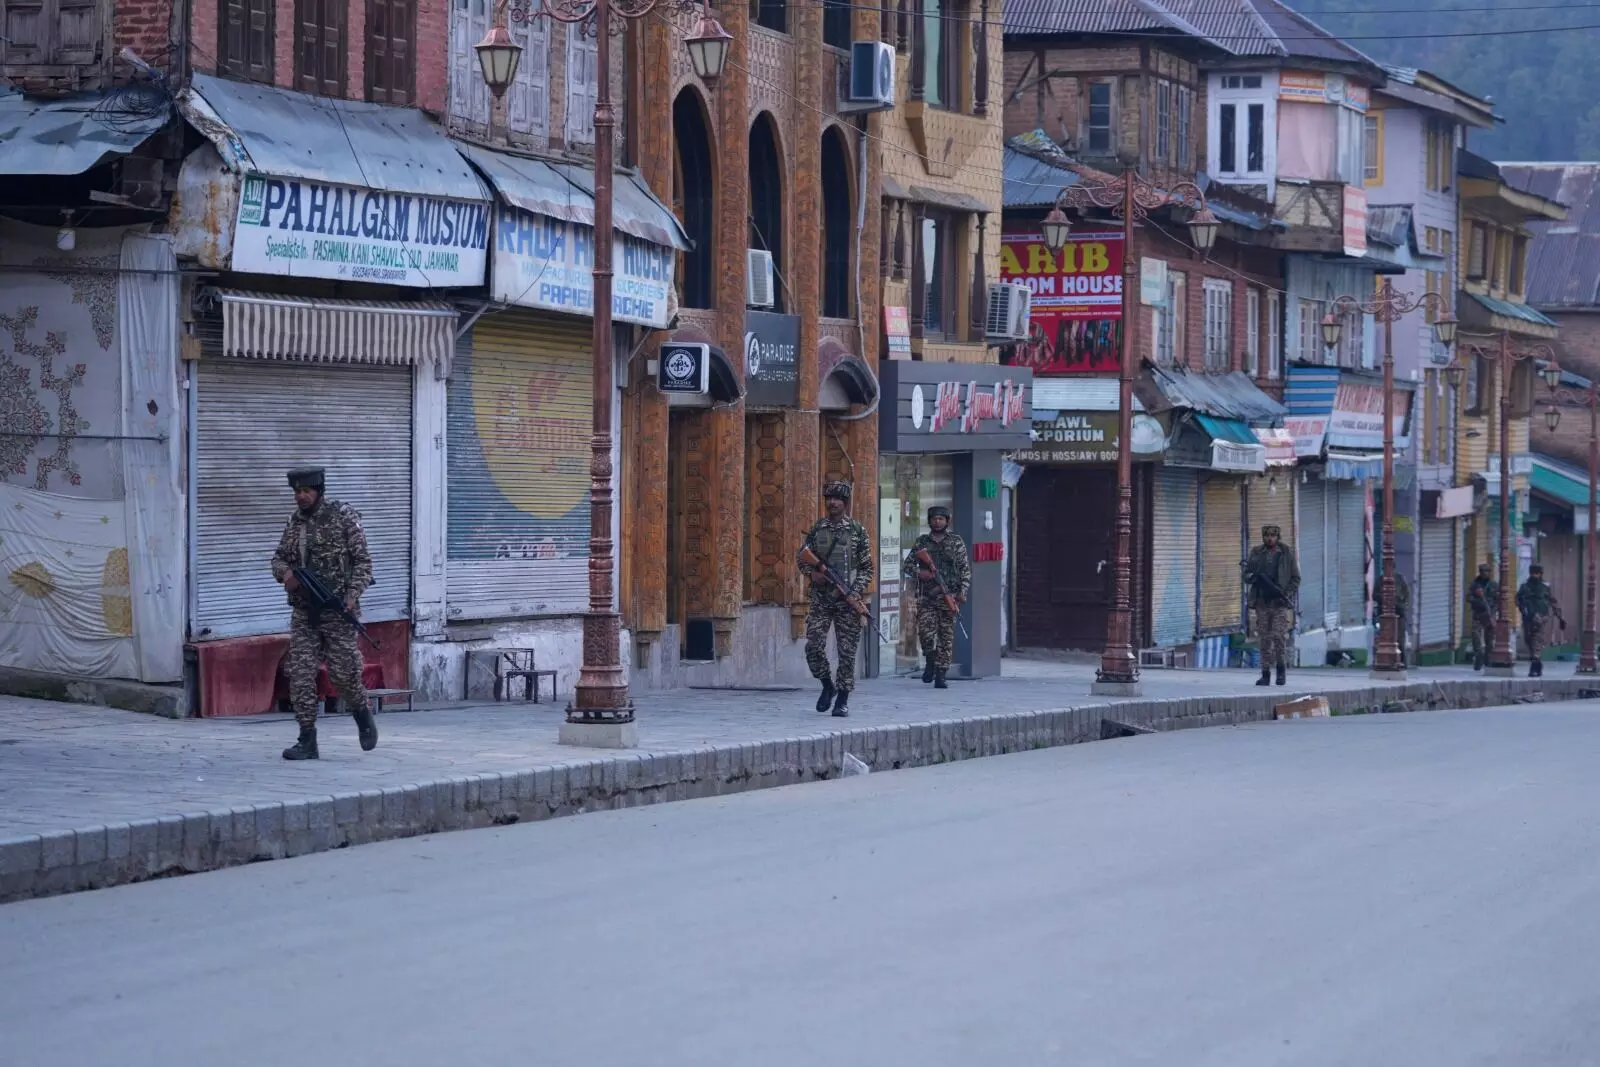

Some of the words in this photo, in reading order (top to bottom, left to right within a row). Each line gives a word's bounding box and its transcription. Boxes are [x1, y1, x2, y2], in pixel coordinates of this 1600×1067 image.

[260, 178, 410, 242] PAHALGAM
[415, 197, 489, 249] MUSIUM
[1062, 275, 1123, 294] HOUSE
[761, 344, 794, 361] PARADISE
